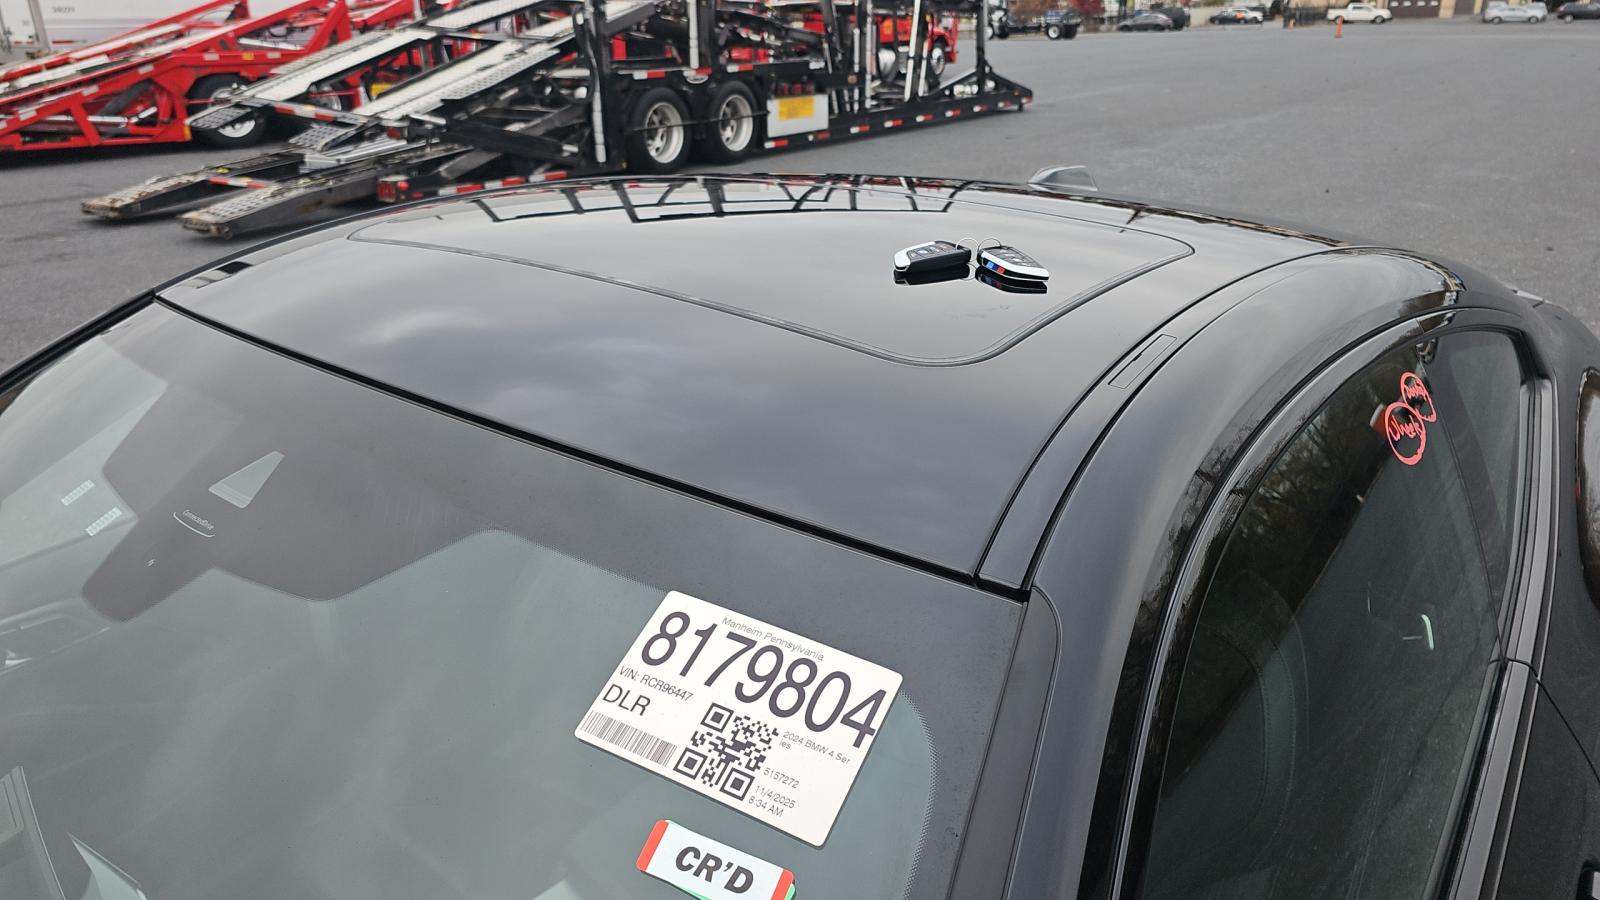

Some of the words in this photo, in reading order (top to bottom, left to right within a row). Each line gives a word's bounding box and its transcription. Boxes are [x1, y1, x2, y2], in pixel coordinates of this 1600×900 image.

[722, 617, 766, 639] Manheim
[764, 632, 825, 662] Pennsylvania
[619, 665, 640, 681] VIN:
[640, 674, 695, 702] RCR96447
[641, 611, 887, 749] 8179804
[602, 684, 651, 716] DLR
[783, 731, 804, 744] 2024
[805, 740, 828, 755] BMW
[828, 750, 835, 758] 4
[835, 752, 851, 765] Ser
[755, 785, 796, 809] 11/4/2025
[767, 804, 784, 818] AM
[675, 846, 754, 894] CR'D
